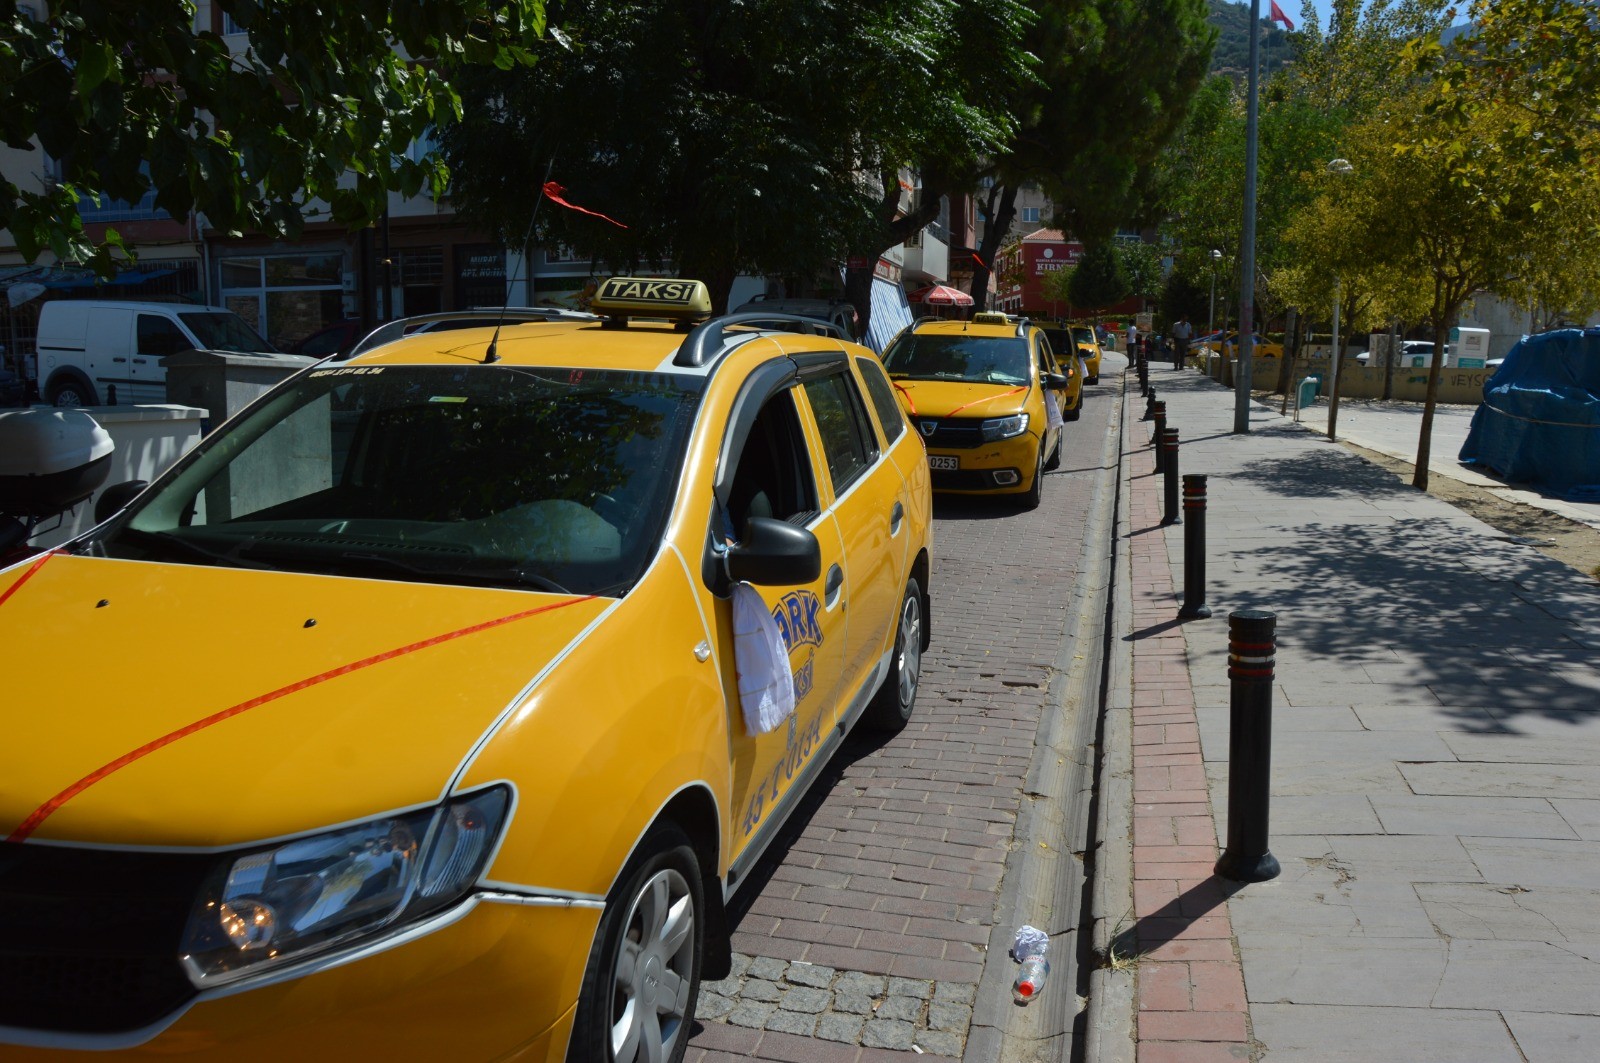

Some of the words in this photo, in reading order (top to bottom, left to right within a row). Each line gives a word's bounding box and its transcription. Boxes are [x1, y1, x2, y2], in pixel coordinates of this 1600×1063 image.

[930, 457, 957, 469] 0253
[772, 590, 825, 656] ARK
[743, 776, 768, 837] 45
[771, 758, 785, 801] T
[786, 706, 823, 780] 0134
